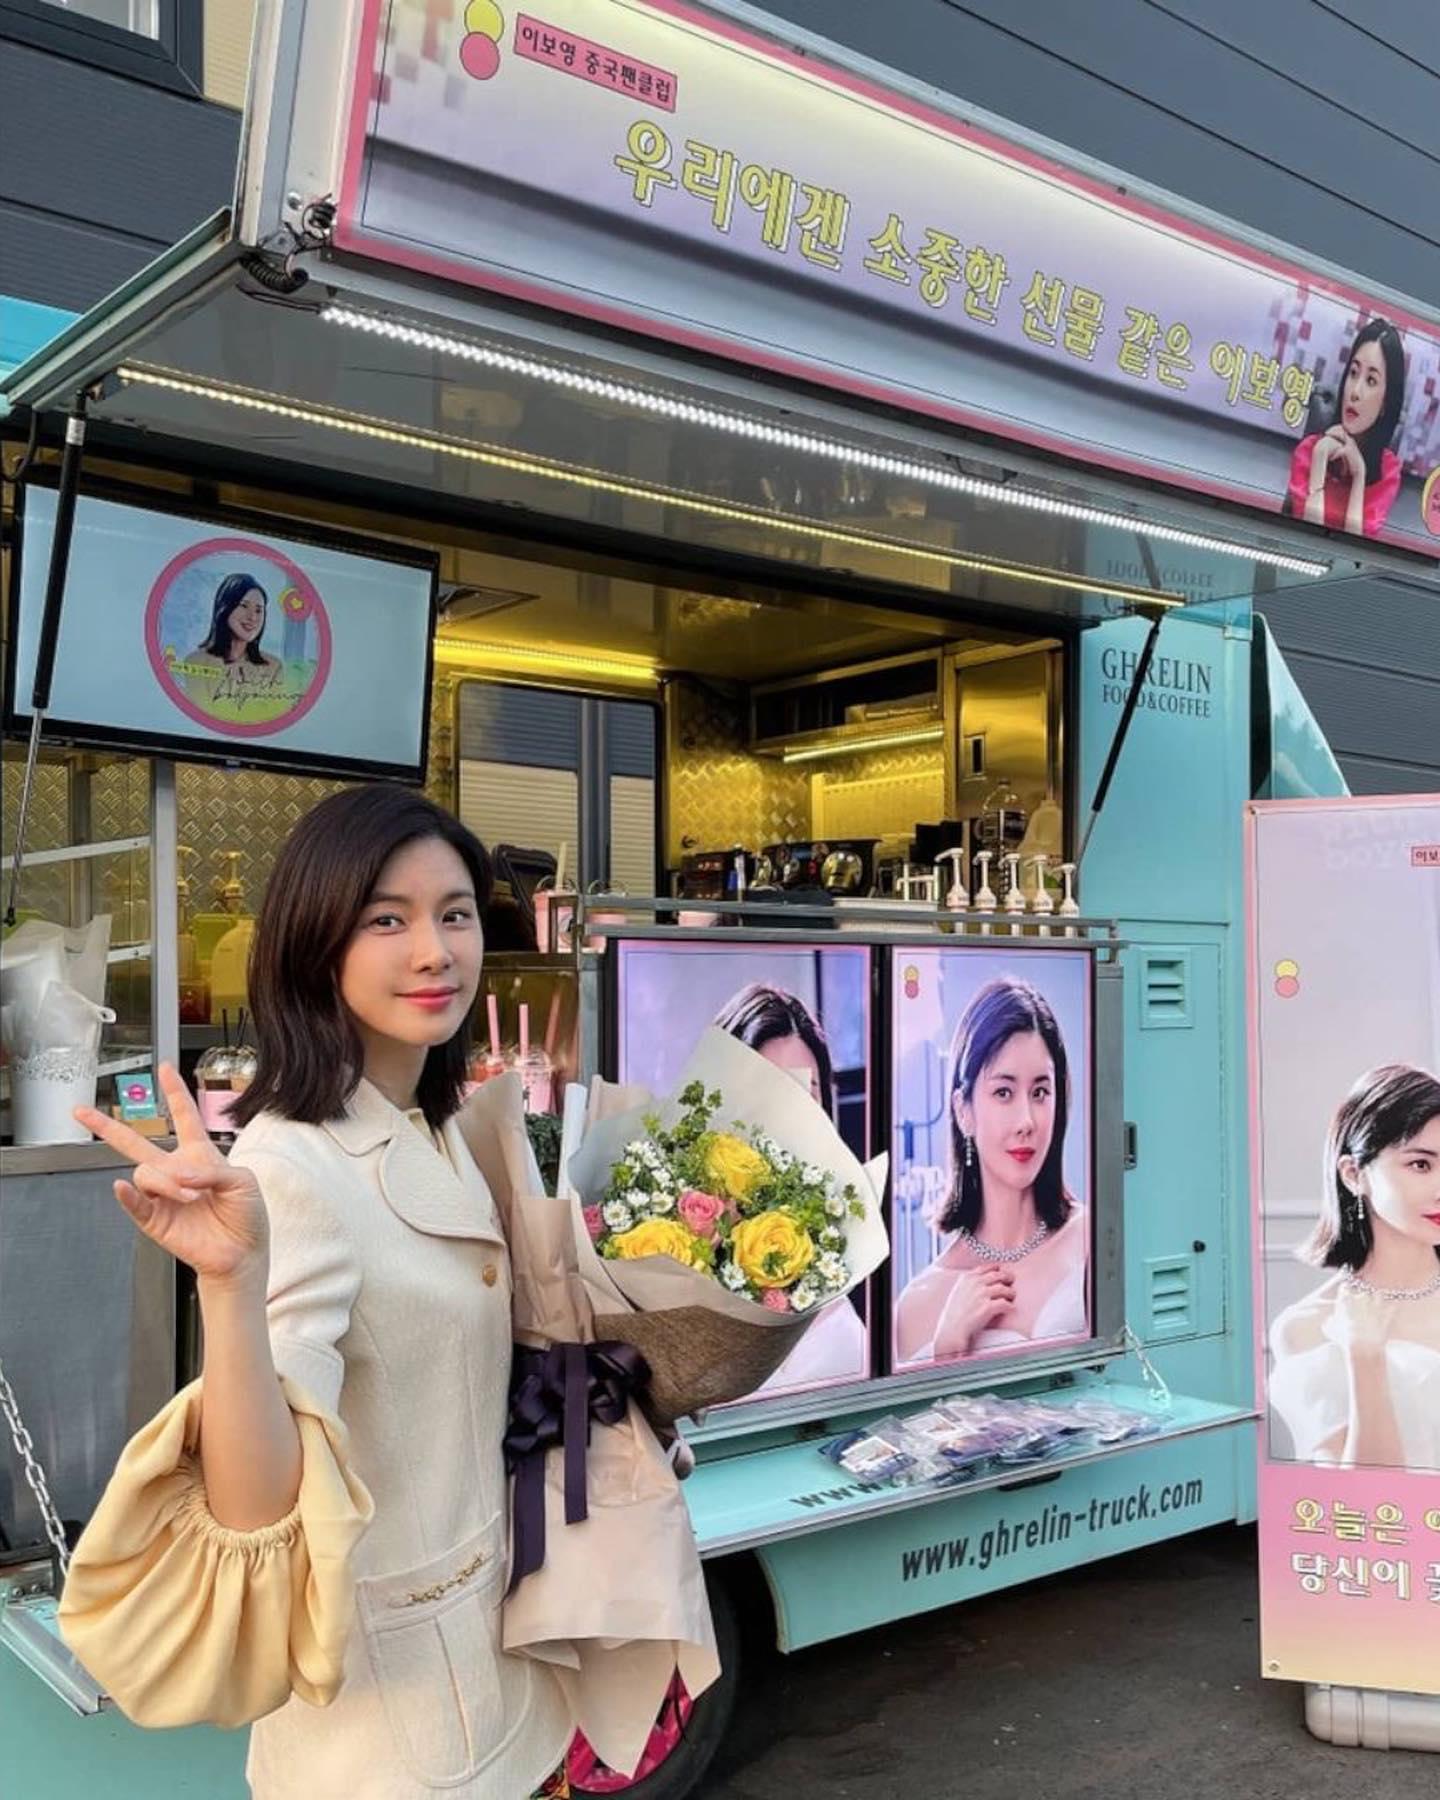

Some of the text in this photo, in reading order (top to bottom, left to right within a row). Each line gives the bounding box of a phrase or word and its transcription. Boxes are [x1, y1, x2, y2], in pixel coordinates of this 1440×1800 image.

[522, 26, 671, 103] 이보영 중국팬클럽
[614, 119, 1315, 428] 우리에겐 소중한 선물 같은 이보영
[902, 1478, 1203, 1582] www.ghrelin-truck.com
[1289, 1498, 1412, 1545] 오늘은
[1290, 1552, 1412, 1601] 당신이
